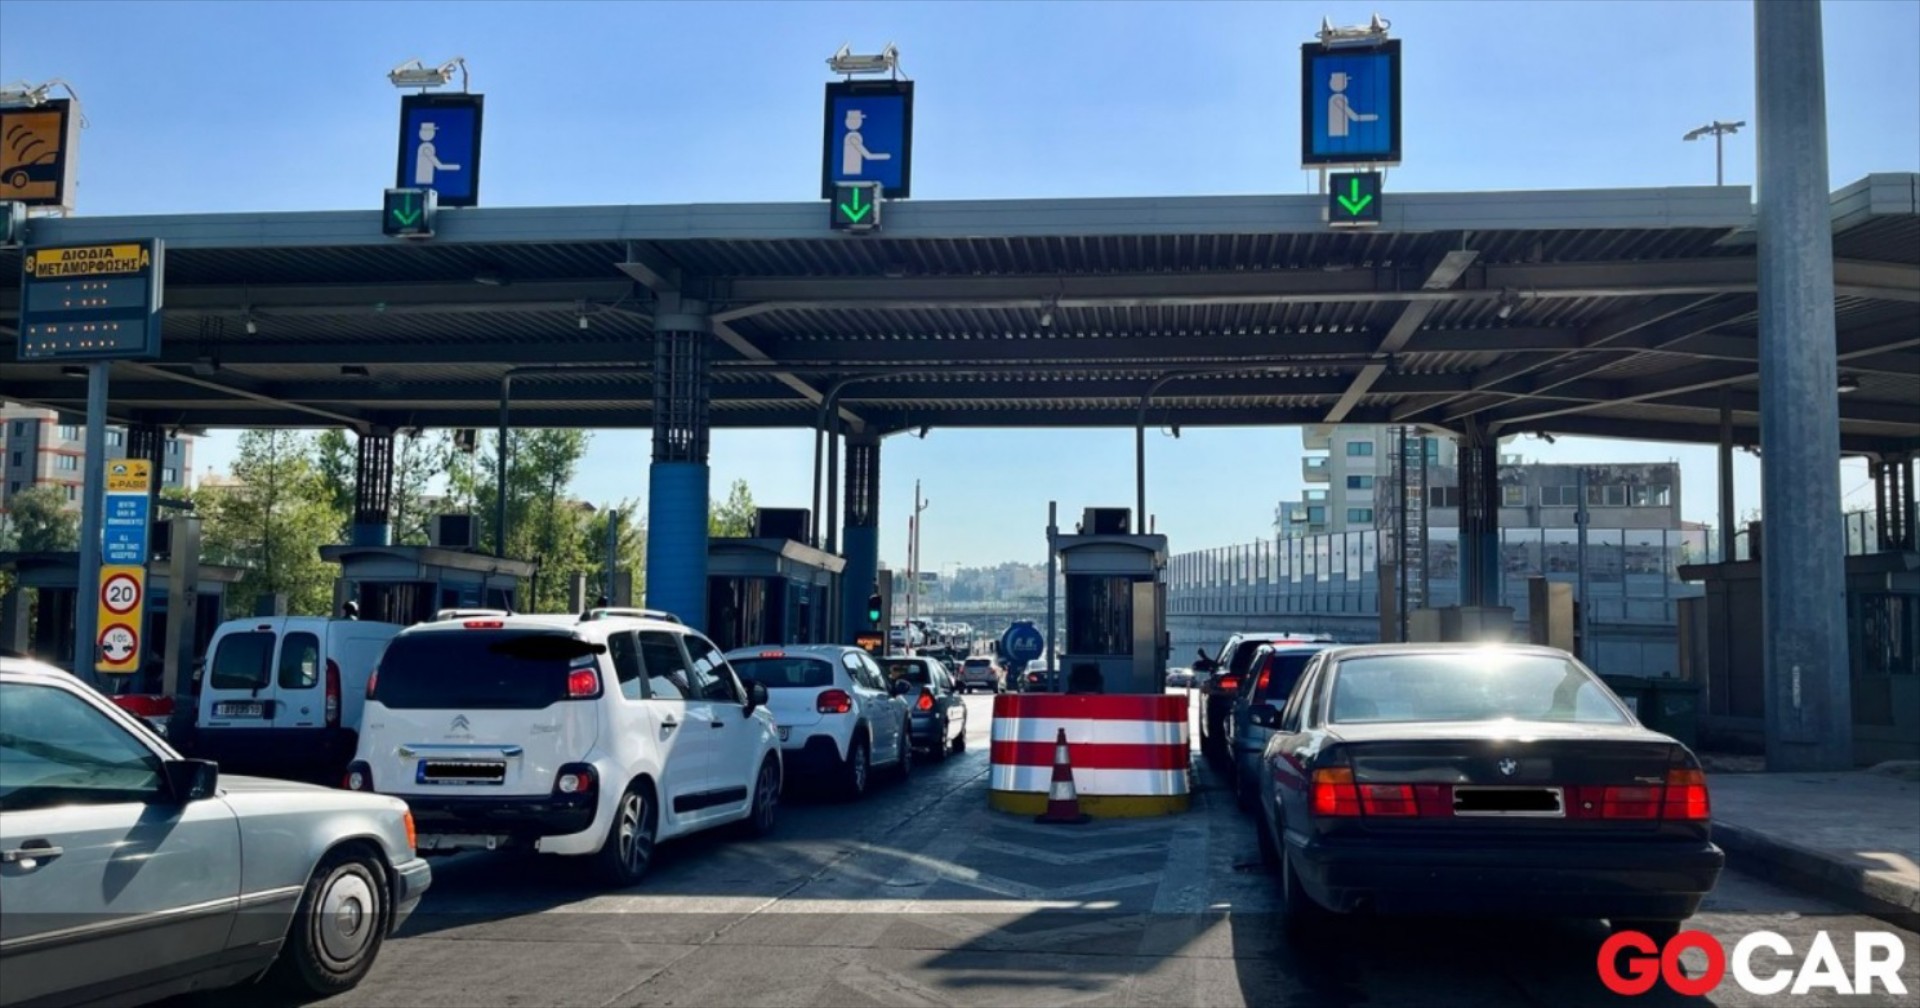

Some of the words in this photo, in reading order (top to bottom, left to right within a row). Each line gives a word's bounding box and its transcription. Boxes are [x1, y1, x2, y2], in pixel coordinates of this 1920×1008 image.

[61, 248, 114, 261] ΔΙΟΔΙΑ
[38, 258, 139, 276] ΜΕΤΑΜΟΡΦΩΣΗΣ
[110, 586, 133, 602] 20
